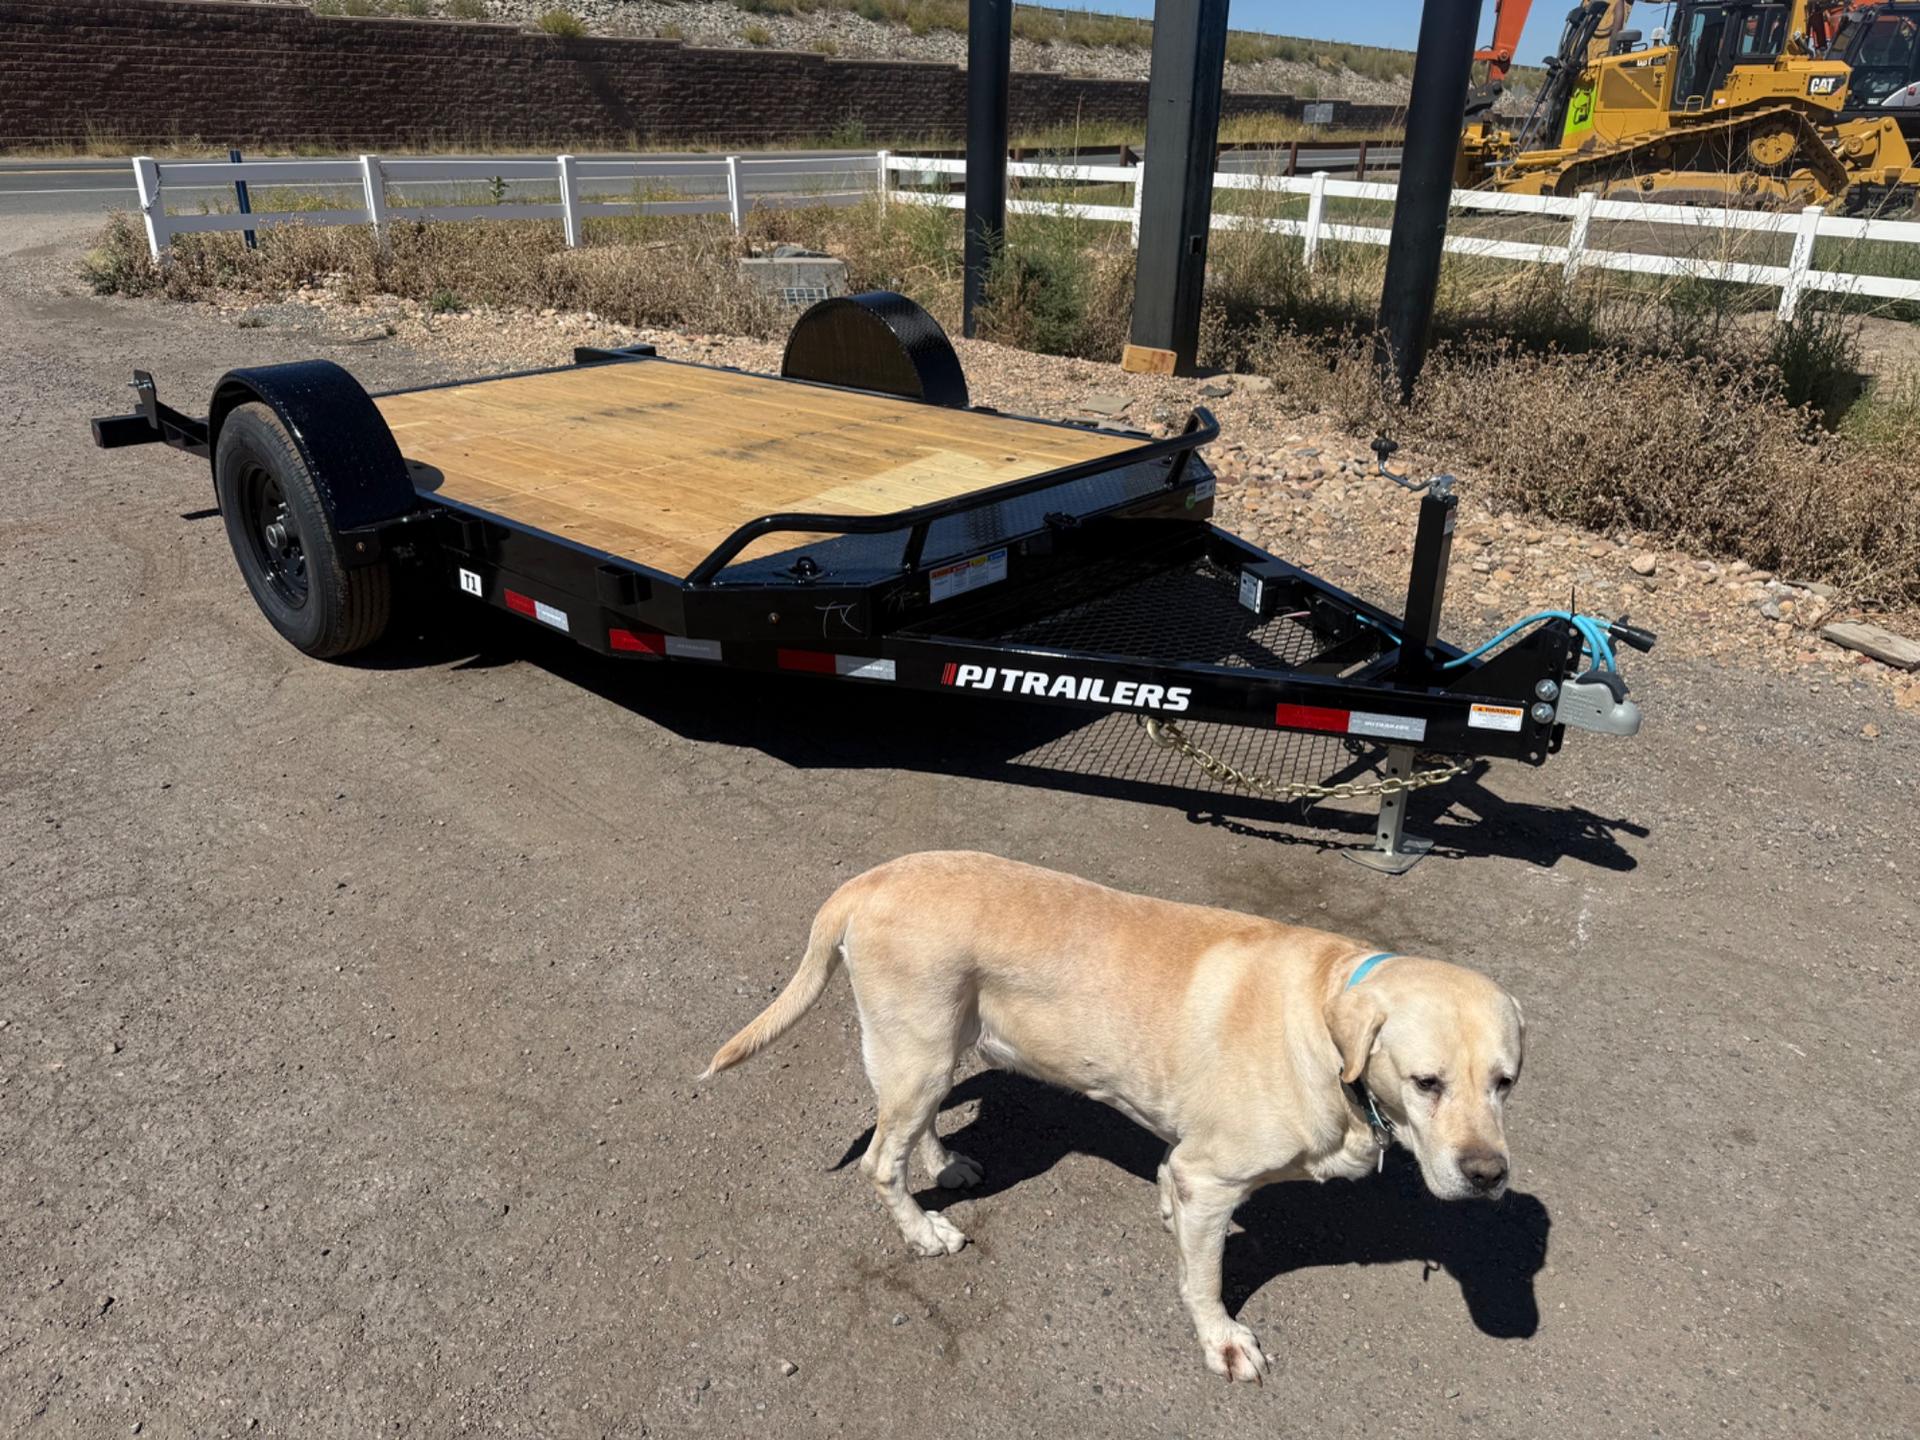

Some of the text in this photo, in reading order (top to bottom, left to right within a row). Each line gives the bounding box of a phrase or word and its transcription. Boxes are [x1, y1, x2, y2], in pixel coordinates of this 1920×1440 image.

[1810, 78, 1836, 93] CAT
[955, 664, 1192, 712] PJ TRAILERS
